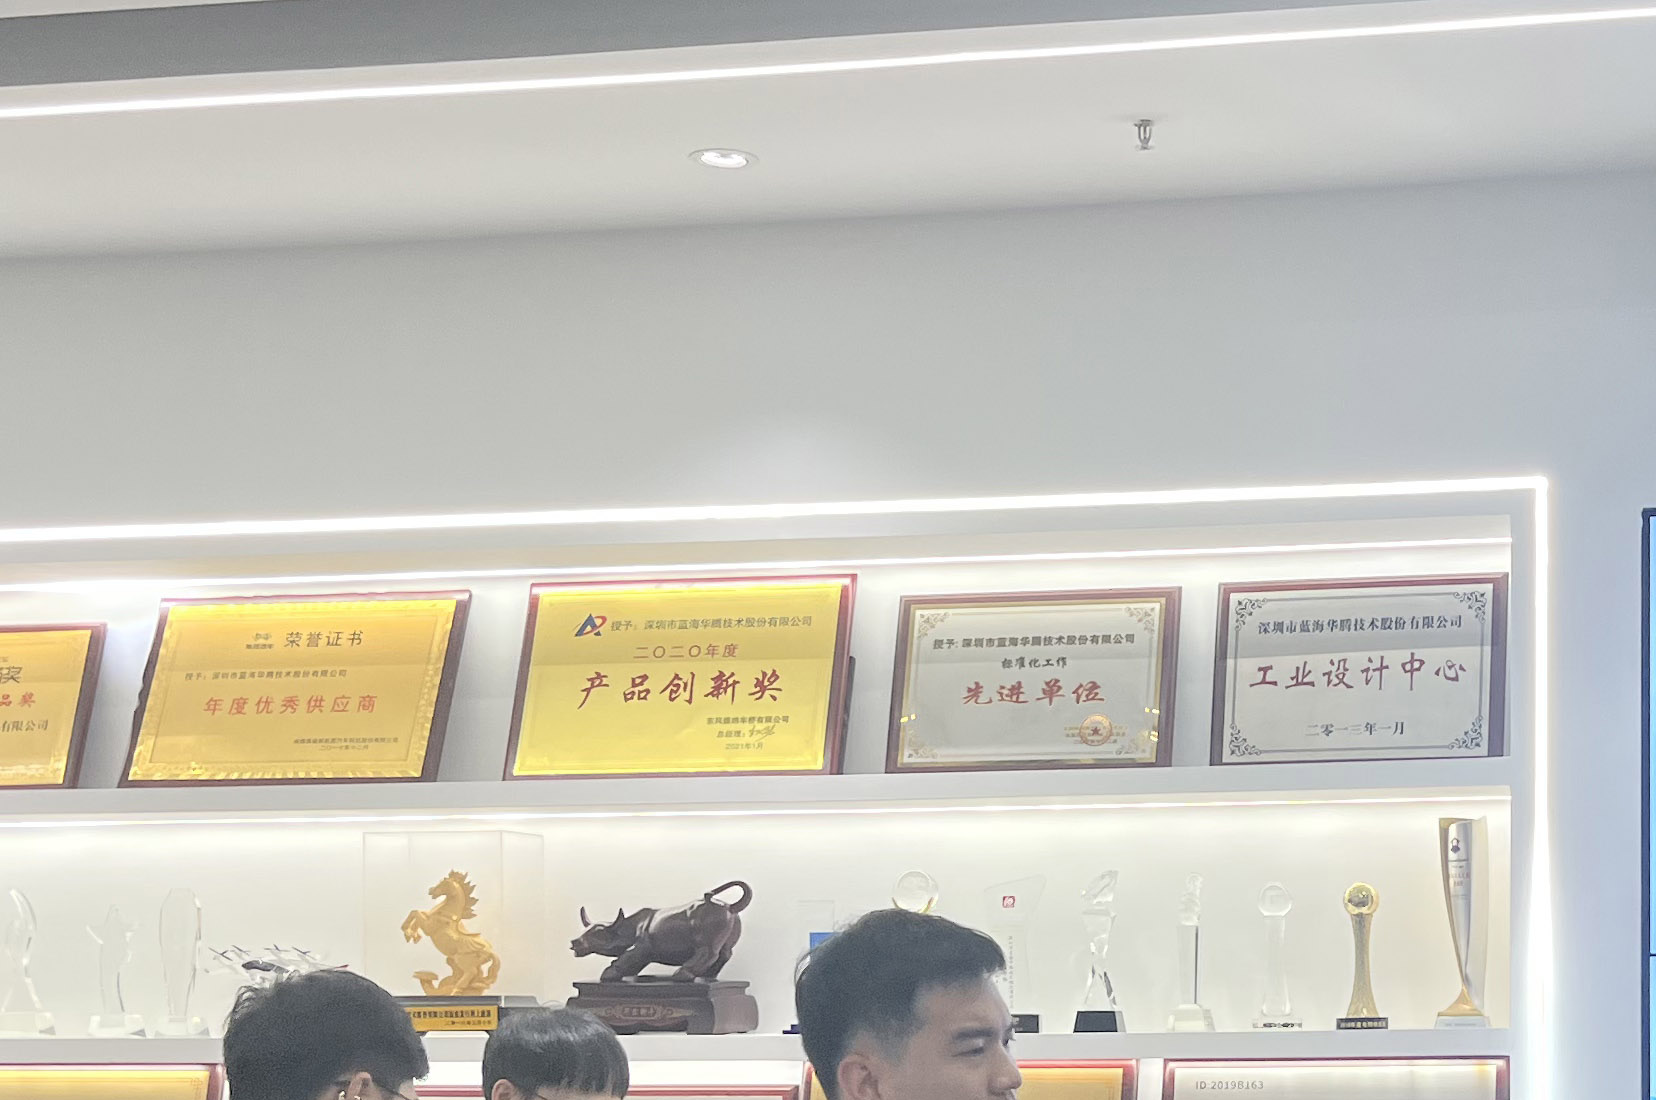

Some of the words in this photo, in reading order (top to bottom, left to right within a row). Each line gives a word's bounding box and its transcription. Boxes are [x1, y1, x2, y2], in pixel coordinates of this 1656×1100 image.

[1257, 614, 1463, 635] 深圳市蓝海华腾技术股份有限公司
[284, 629, 364, 649] 荣誉证书
[1001, 656, 1068, 670] 标准化工作
[1249, 651, 1467, 692] 工业设计中心
[576, 668, 783, 710] 产品创新奖
[962, 677, 1105, 707] 先进单位
[203, 694, 378, 716] 年度优秀供应商
[1304, 721, 1405, 737] 二零一三年一月
